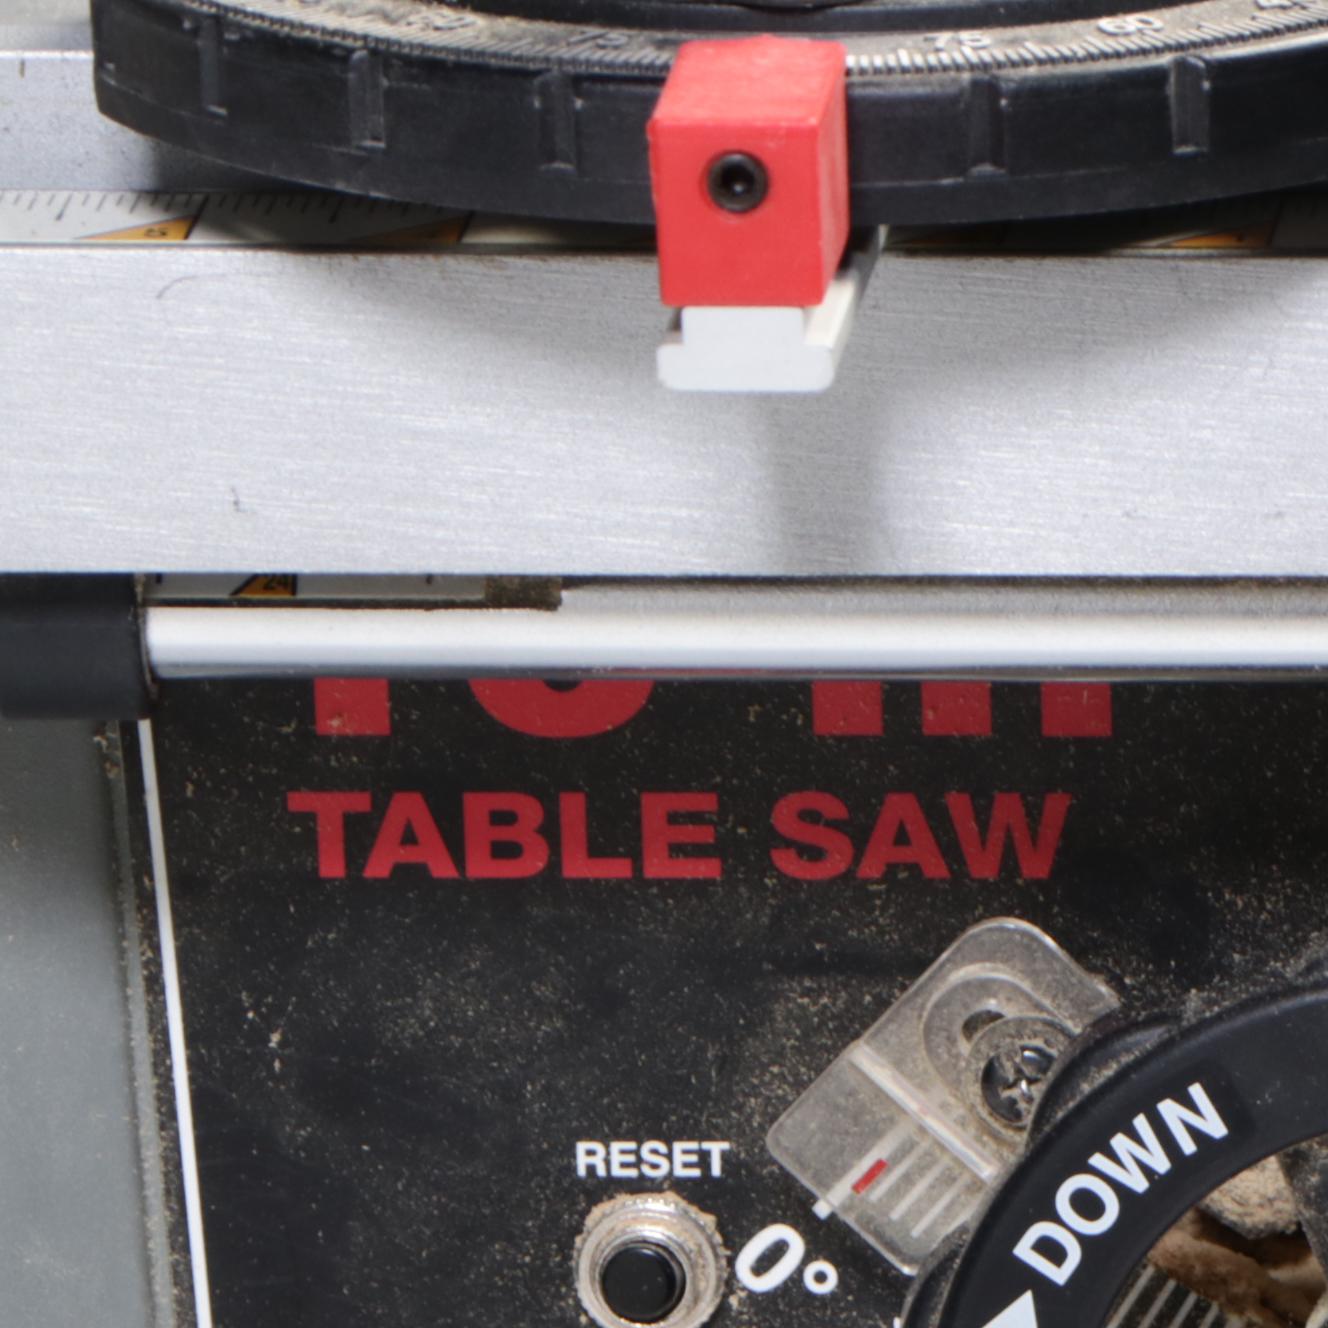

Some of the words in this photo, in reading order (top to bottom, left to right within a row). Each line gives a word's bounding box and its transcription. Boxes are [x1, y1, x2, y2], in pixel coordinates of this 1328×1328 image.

[923, 32, 993, 51] 75
[1099, 16, 1165, 37] 60
[287, 791, 722, 879] TABLE
[770, 790, 1073, 881] SAW
[576, 1141, 730, 1178] RESET
[1012, 1082, 1229, 1286] DOWN
